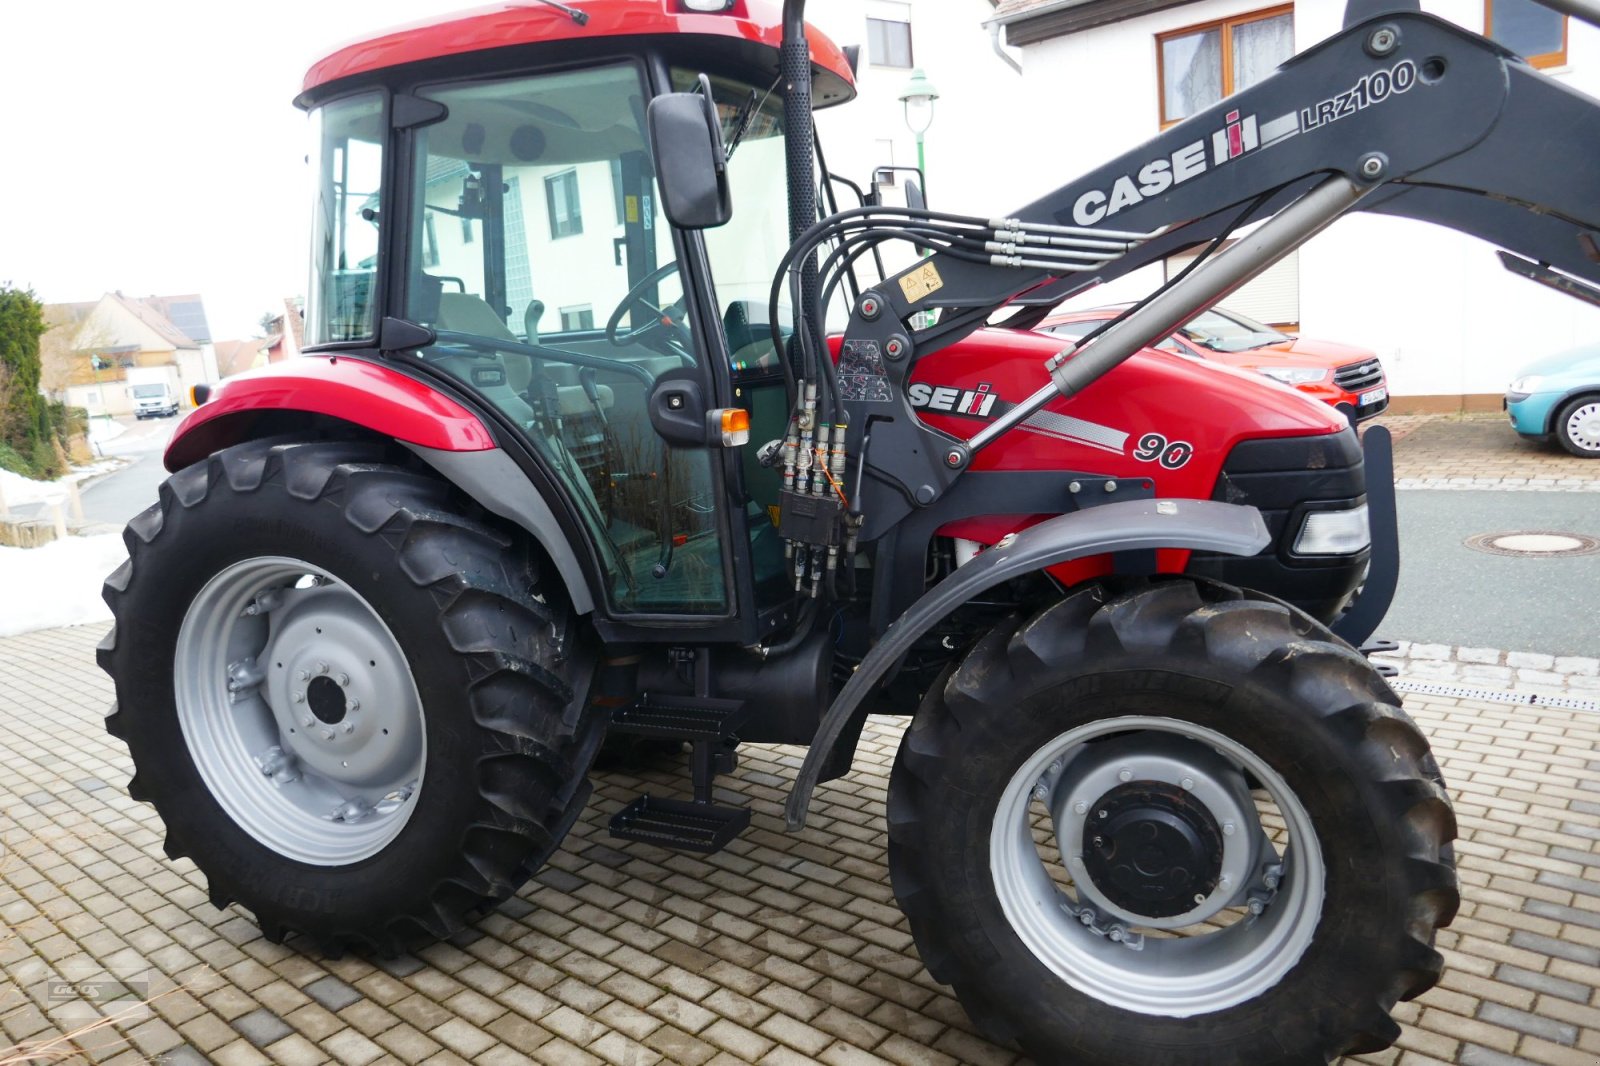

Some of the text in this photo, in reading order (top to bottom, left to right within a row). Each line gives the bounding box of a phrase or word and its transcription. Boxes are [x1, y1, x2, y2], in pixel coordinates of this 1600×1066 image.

[1073, 140, 1207, 226] CASE
[1302, 60, 1415, 133] LRZ100
[908, 383, 956, 412] SE
[1133, 433, 1193, 470] 90
